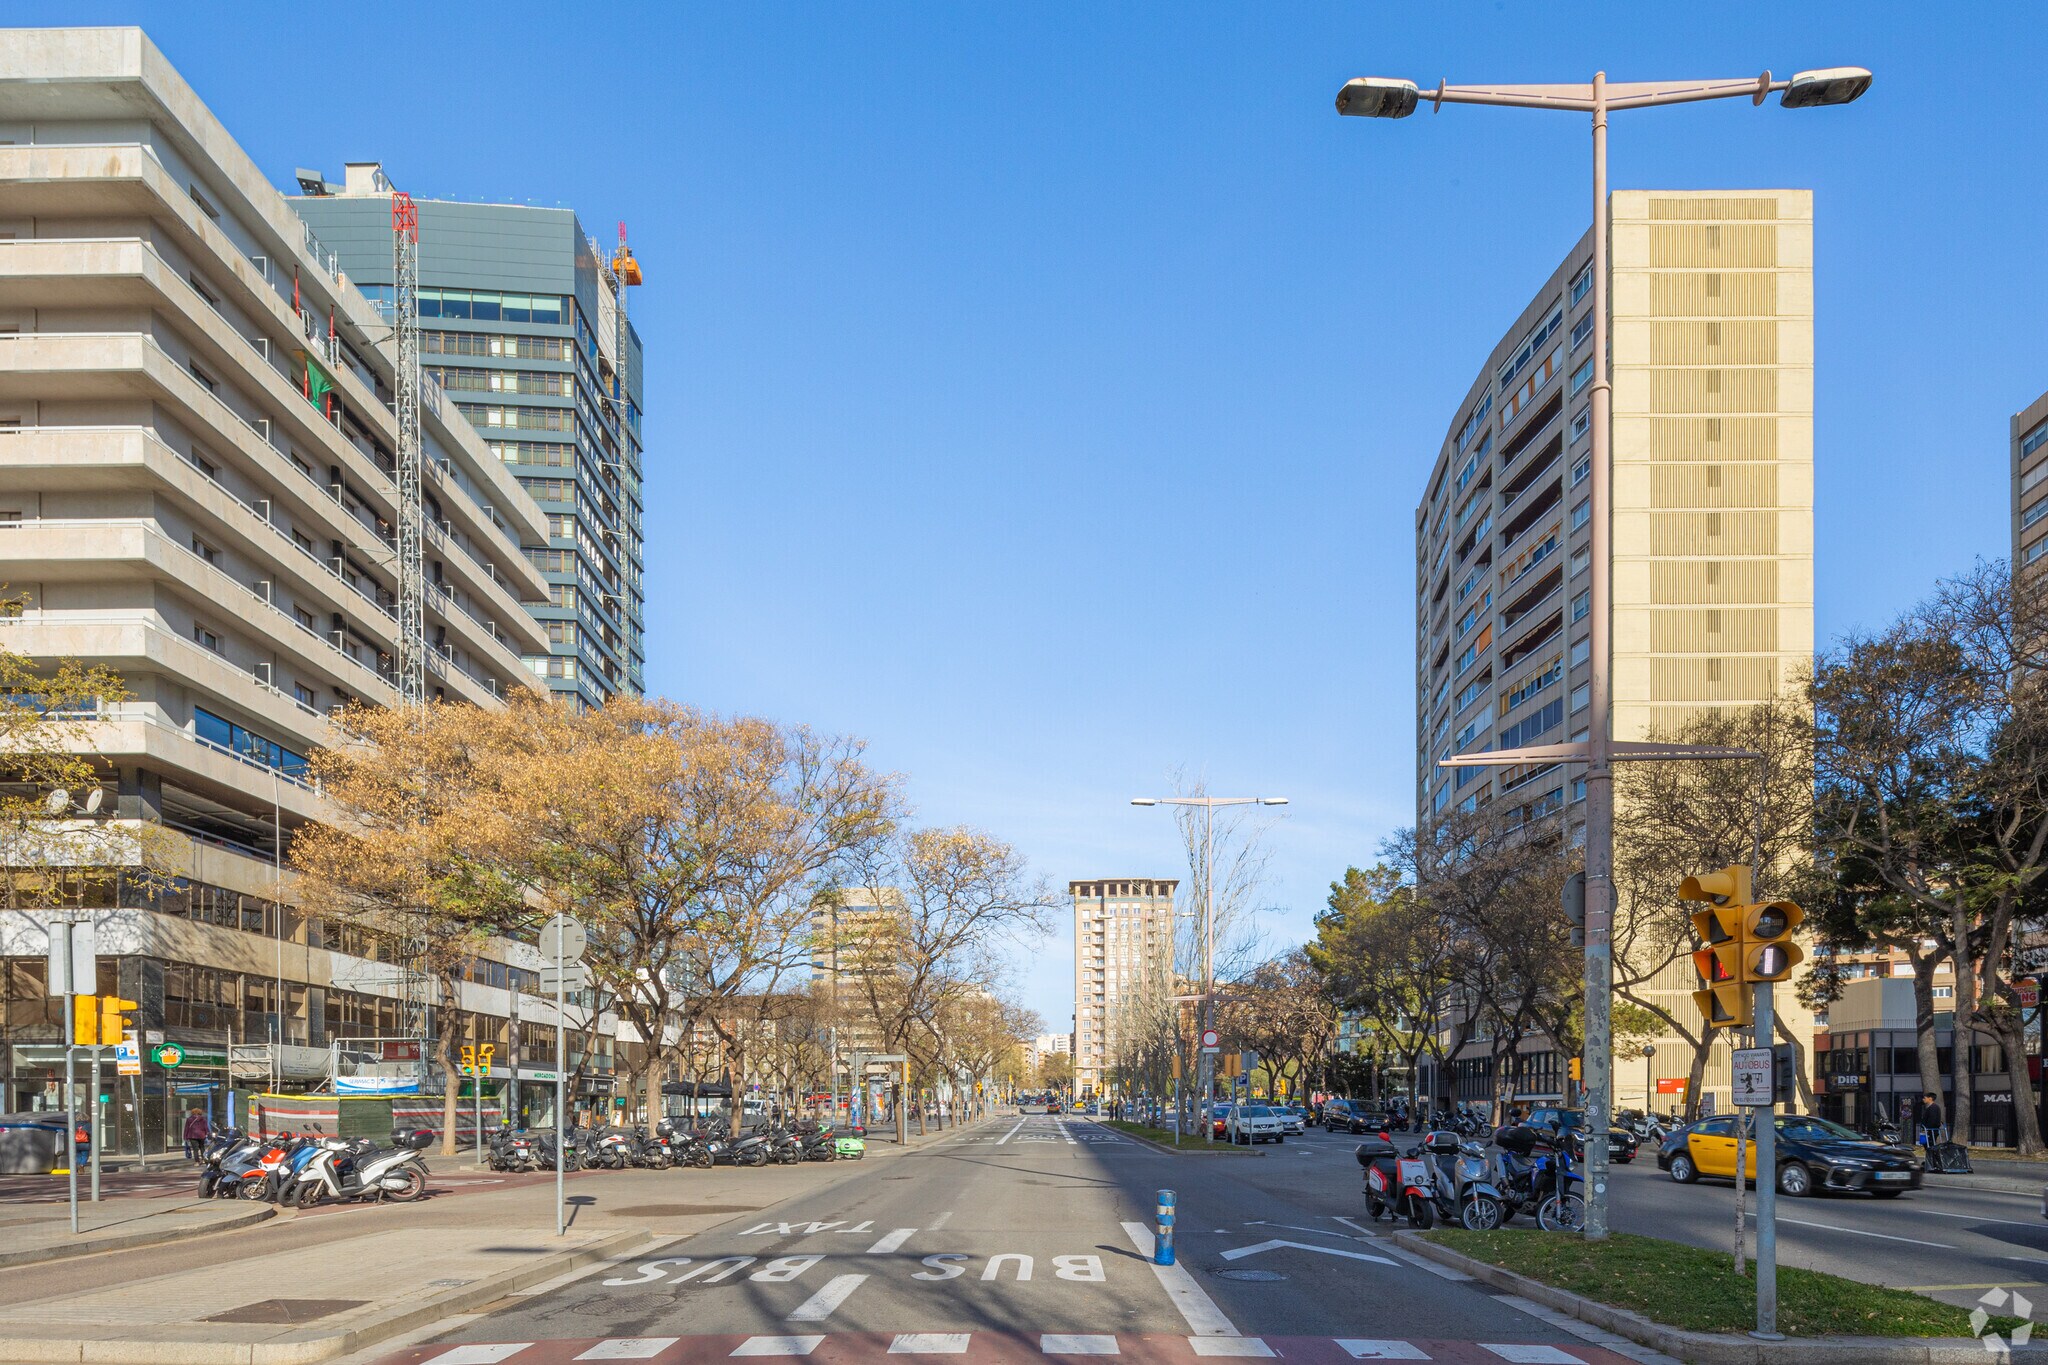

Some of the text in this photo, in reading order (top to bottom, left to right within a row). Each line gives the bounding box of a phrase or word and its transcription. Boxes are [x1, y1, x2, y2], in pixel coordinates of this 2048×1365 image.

[2021, 992, 2037, 1002] NG
[1734, 1061, 1770, 1070] AUTOBUS
[1838, 1075, 1859, 1084] DiR
[738, 1220, 876, 1235] TAXI
[602, 1254, 827, 1286] BUS
[910, 1253, 1107, 1282] BUS
